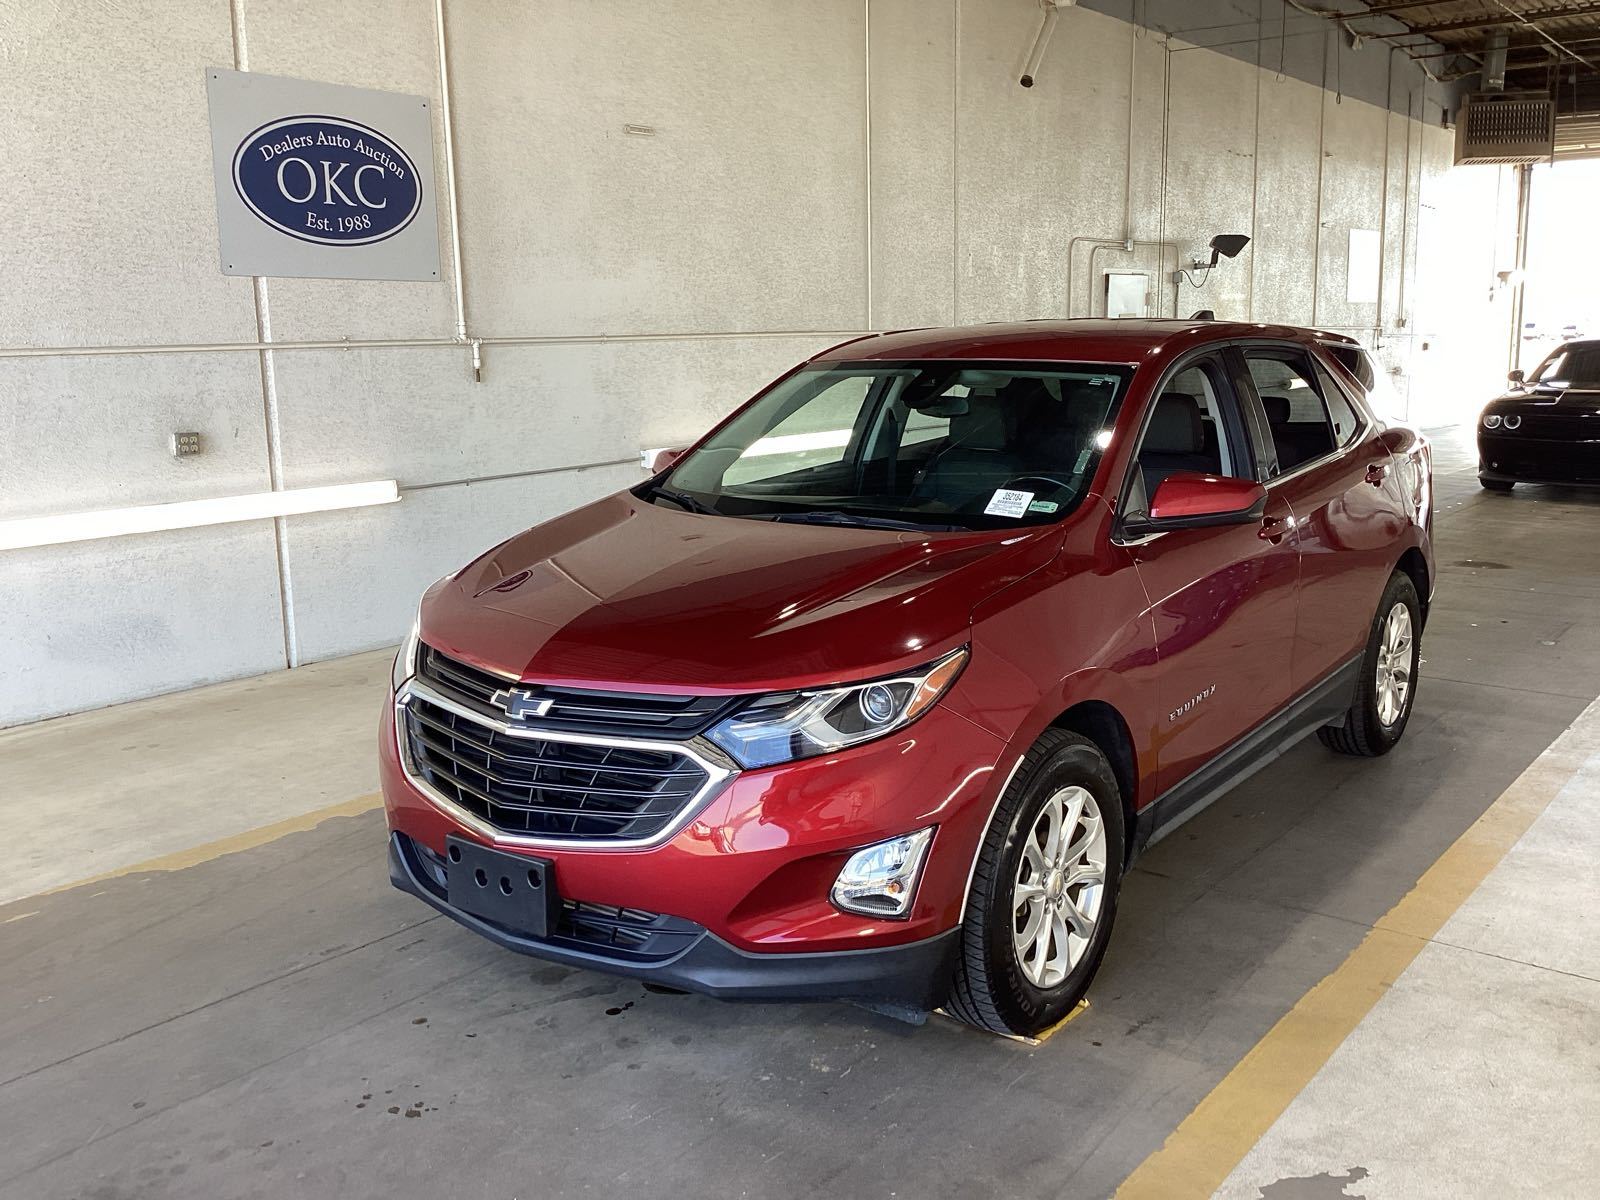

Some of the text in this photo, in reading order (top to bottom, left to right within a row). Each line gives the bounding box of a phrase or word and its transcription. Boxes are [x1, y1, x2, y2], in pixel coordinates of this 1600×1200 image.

[259, 131, 405, 179] Dealers Auto Auction
[277, 157, 387, 209] OKC
[305, 212, 372, 232] Est. 1988
[1168, 684, 1216, 721] EQUINOX
